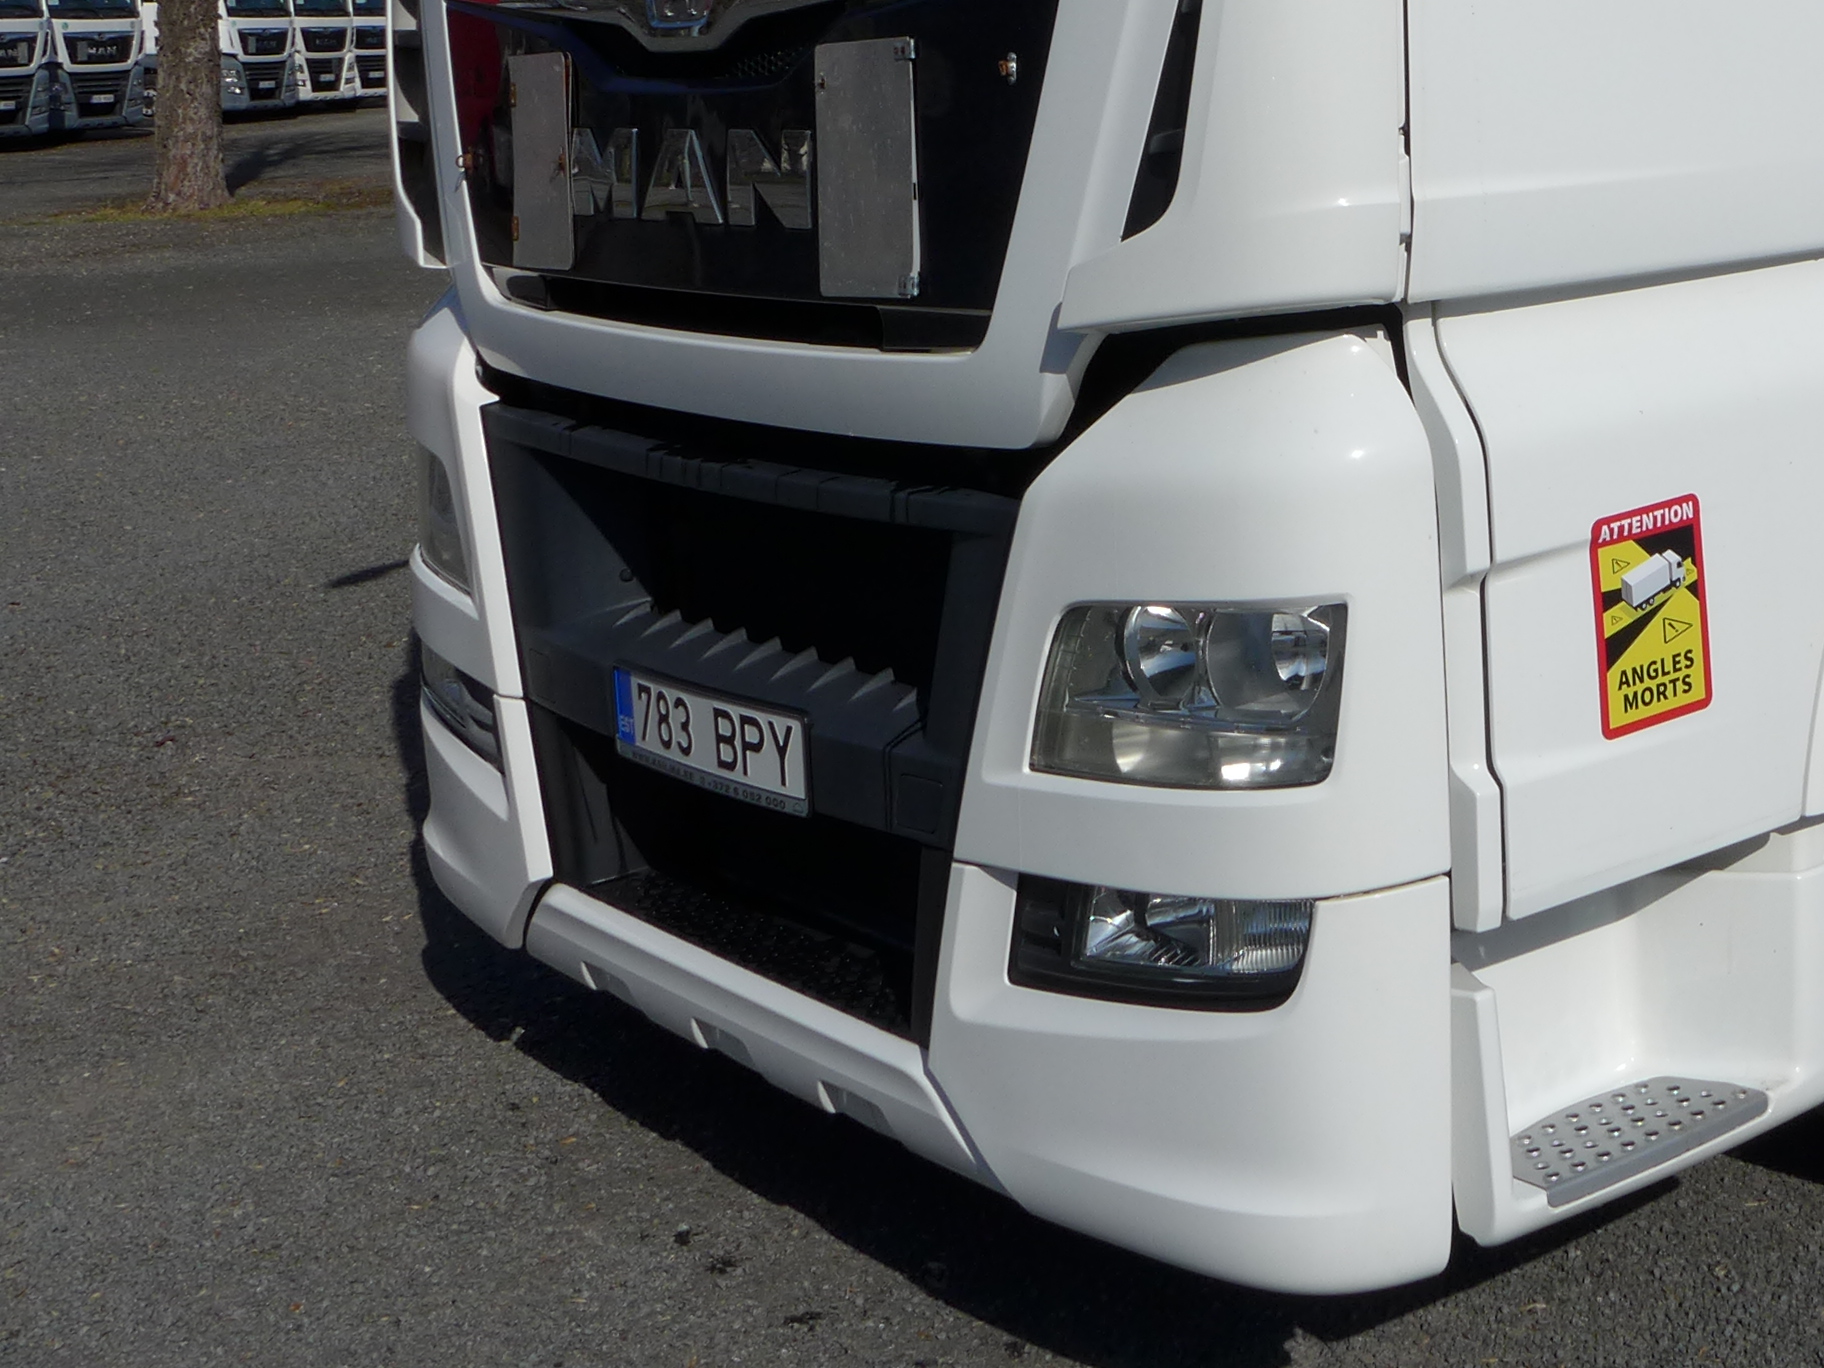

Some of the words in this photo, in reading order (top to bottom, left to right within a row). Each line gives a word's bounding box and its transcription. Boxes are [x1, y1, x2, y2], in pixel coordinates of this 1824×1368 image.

[87, 45, 118, 57] MAN
[571, 127, 813, 229] MAN
[1598, 501, 1694, 543] ATTENTION
[1617, 648, 1695, 691] ANGLES
[1623, 673, 1693, 714] MORTS
[637, 682, 694, 757] 783
[713, 707, 793, 787] BPY
[765, 795, 786, 810] 000
